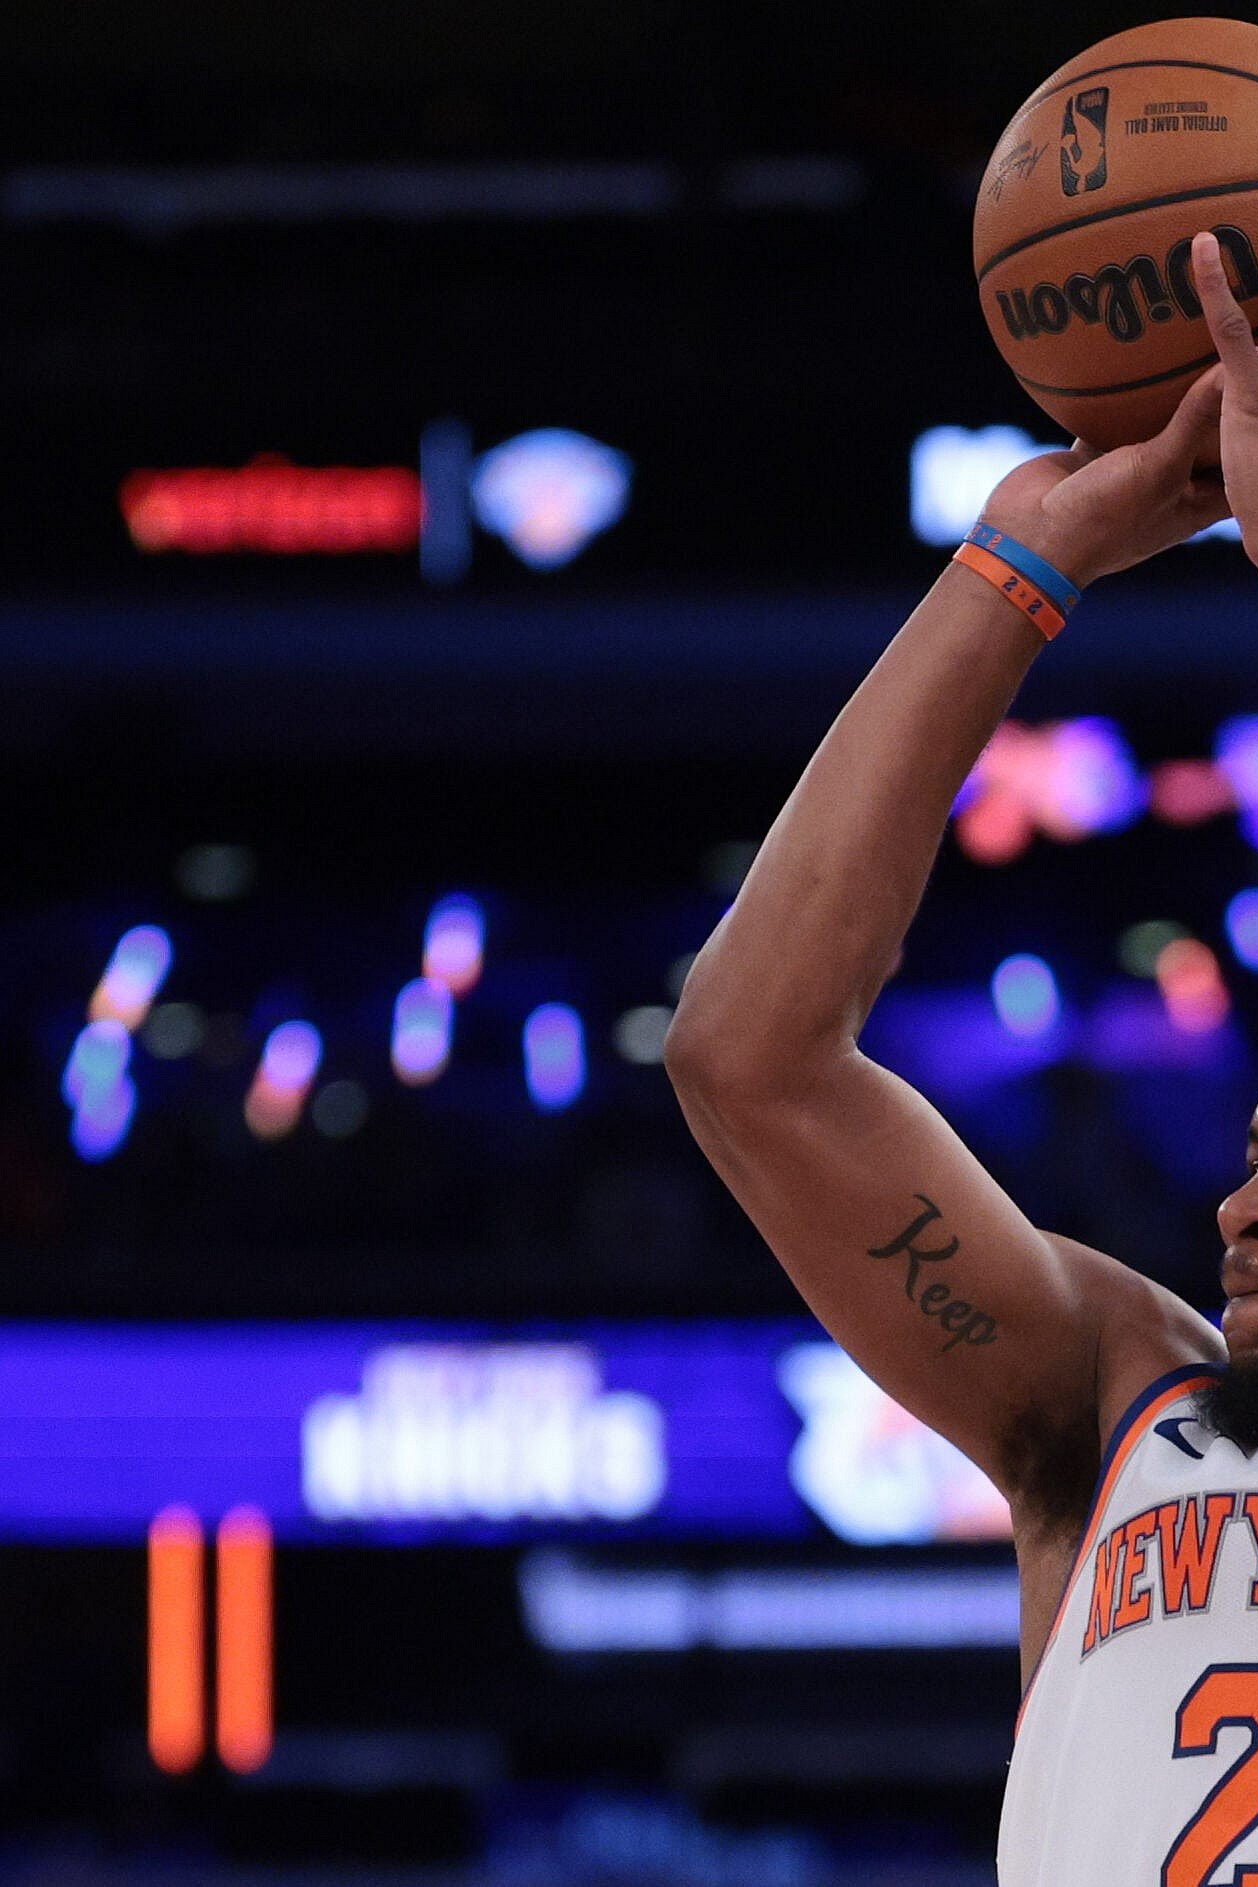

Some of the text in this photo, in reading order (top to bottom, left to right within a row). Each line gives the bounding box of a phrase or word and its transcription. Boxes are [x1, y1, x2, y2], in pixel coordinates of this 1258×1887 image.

[1124, 115, 1228, 135] OFFICIAL GAME BALL
[866, 1193, 998, 1353] Keep
[1081, 1490, 1238, 1664] NEW
